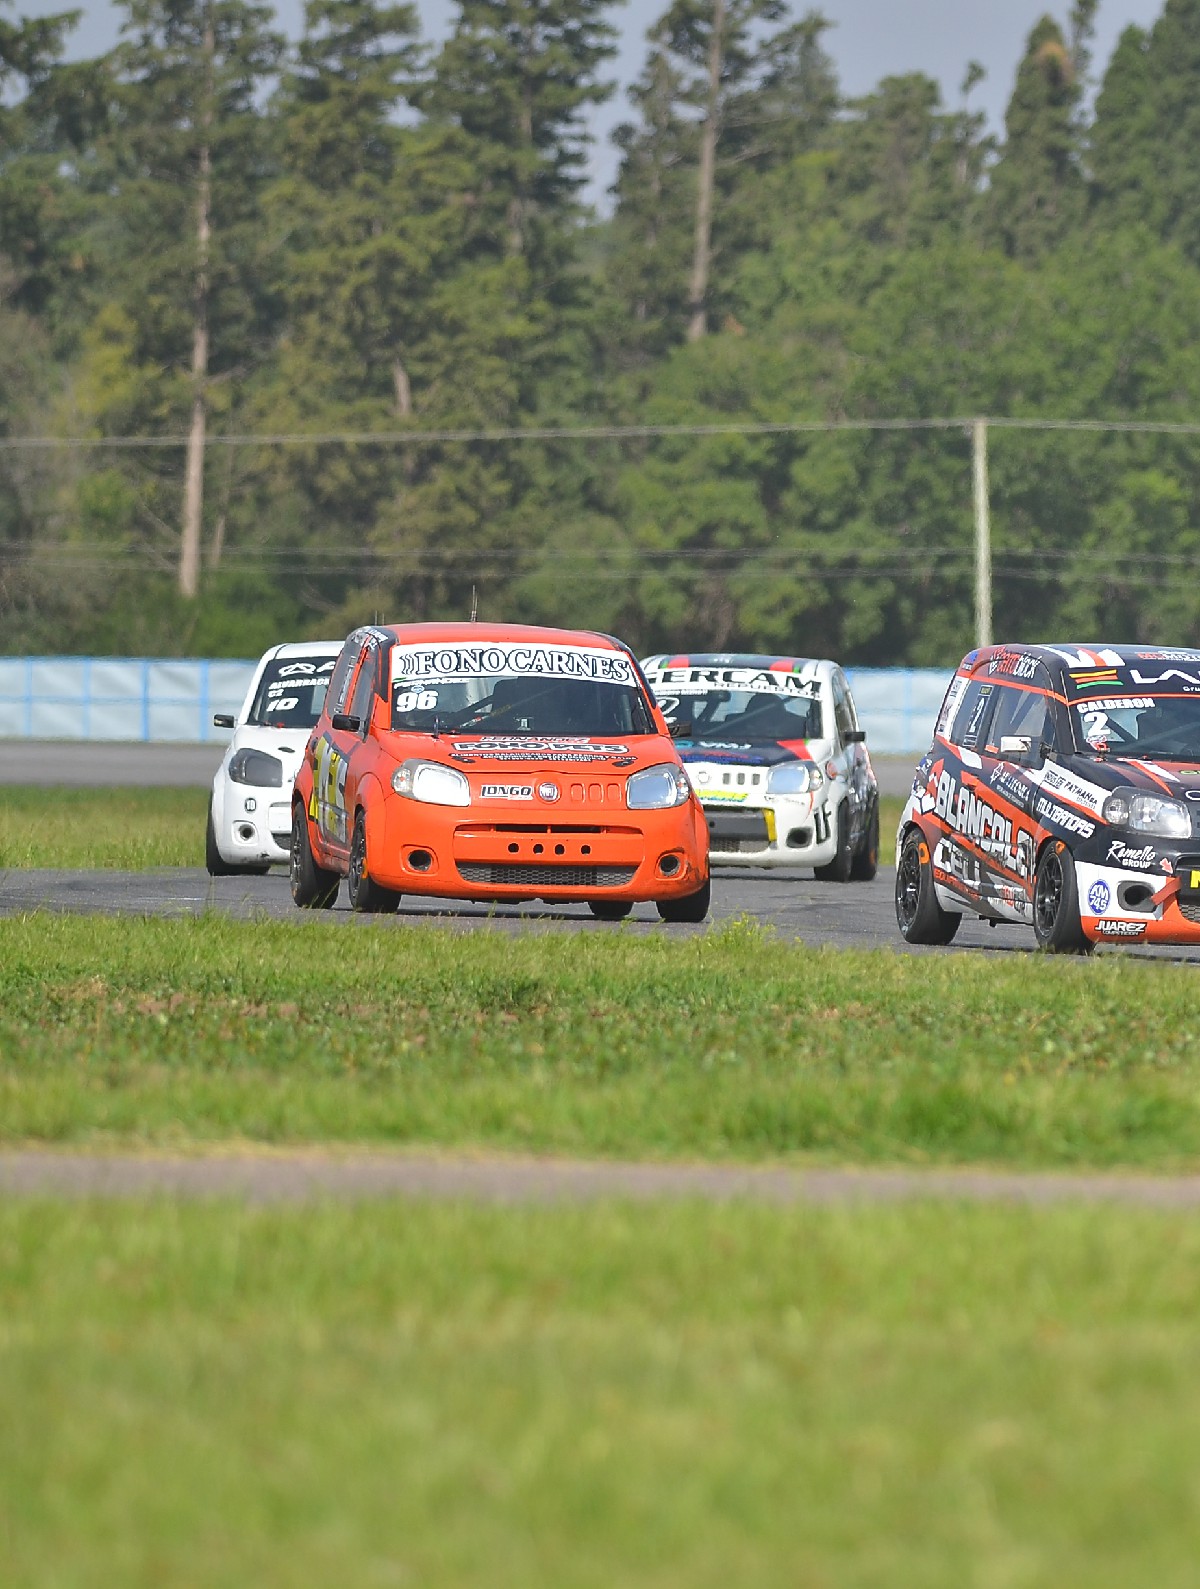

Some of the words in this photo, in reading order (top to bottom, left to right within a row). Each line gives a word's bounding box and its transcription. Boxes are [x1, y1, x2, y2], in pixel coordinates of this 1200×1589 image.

[415, 648, 631, 681] FONOCARNES
[266, 698, 299, 712] 10
[396, 690, 438, 712] 96
[1076, 697, 1156, 713] CALDERON
[1083, 711, 1111, 736] 2
[1122, 858, 1152, 868] GROUP
[1094, 920, 1147, 933] JUAREZ
